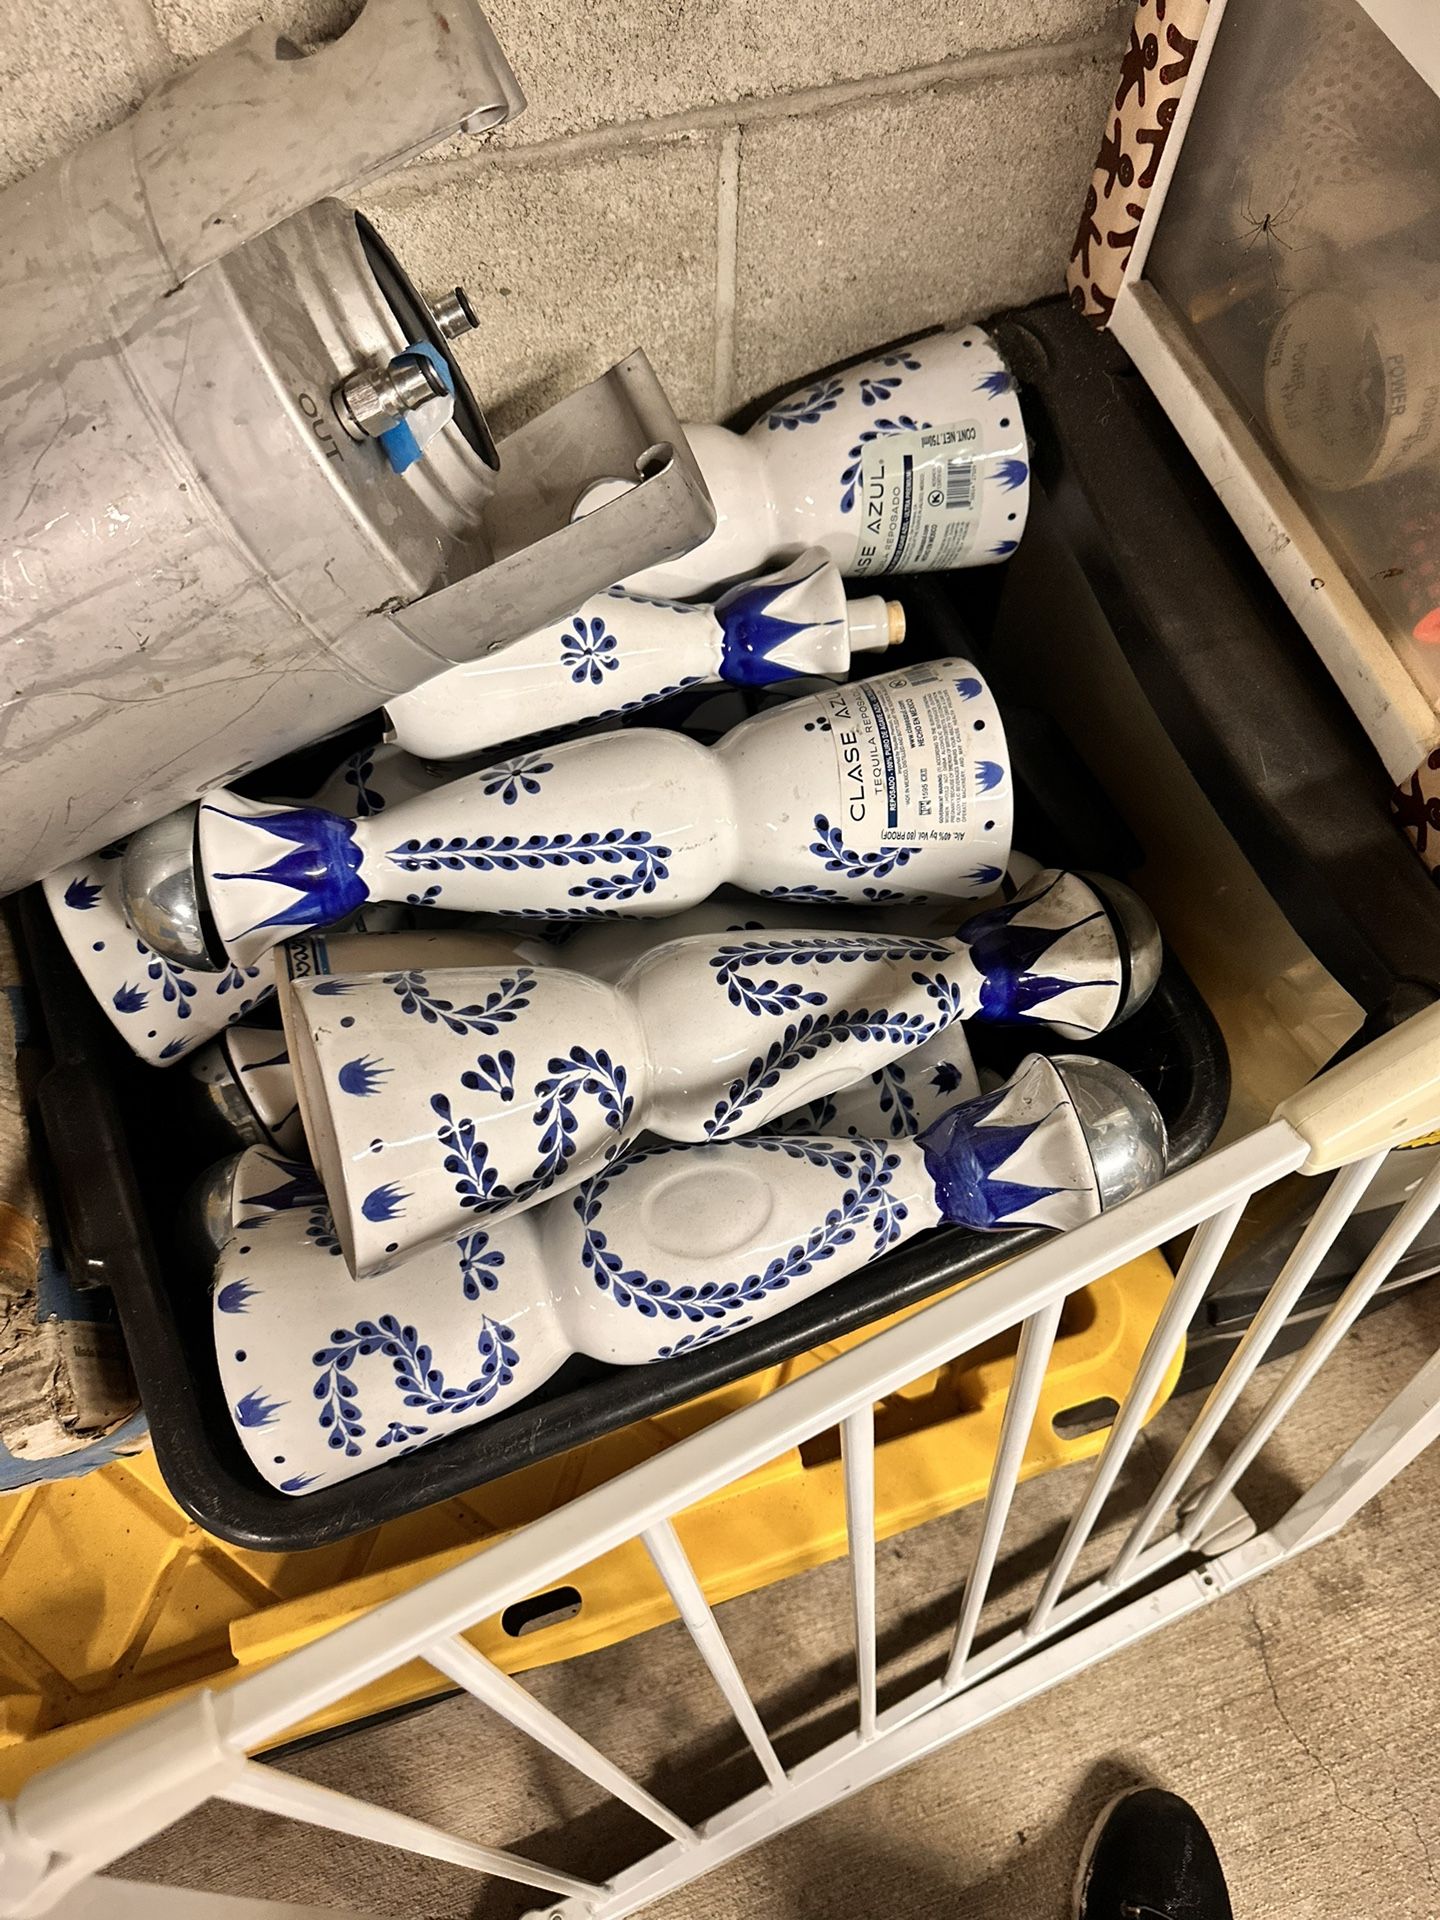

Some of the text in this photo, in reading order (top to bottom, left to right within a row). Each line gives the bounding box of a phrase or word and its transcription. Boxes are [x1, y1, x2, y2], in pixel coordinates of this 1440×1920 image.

[1389, 353, 1408, 416] POWER
[298, 393, 344, 462] OUT
[885, 486, 900, 550] REPOSADO
[903, 500, 911, 518] ULTRA
[881, 730, 888, 738] DE
[912, 717, 920, 725] EN
[884, 738, 892, 756] PURO
[914, 725, 925, 747] HECHO
[825, 689, 865, 822] CLASE AZU
[867, 736, 883, 795] TEQUILA
[886, 757, 894, 772] 100%
[888, 776, 896, 811] REPOSADO
